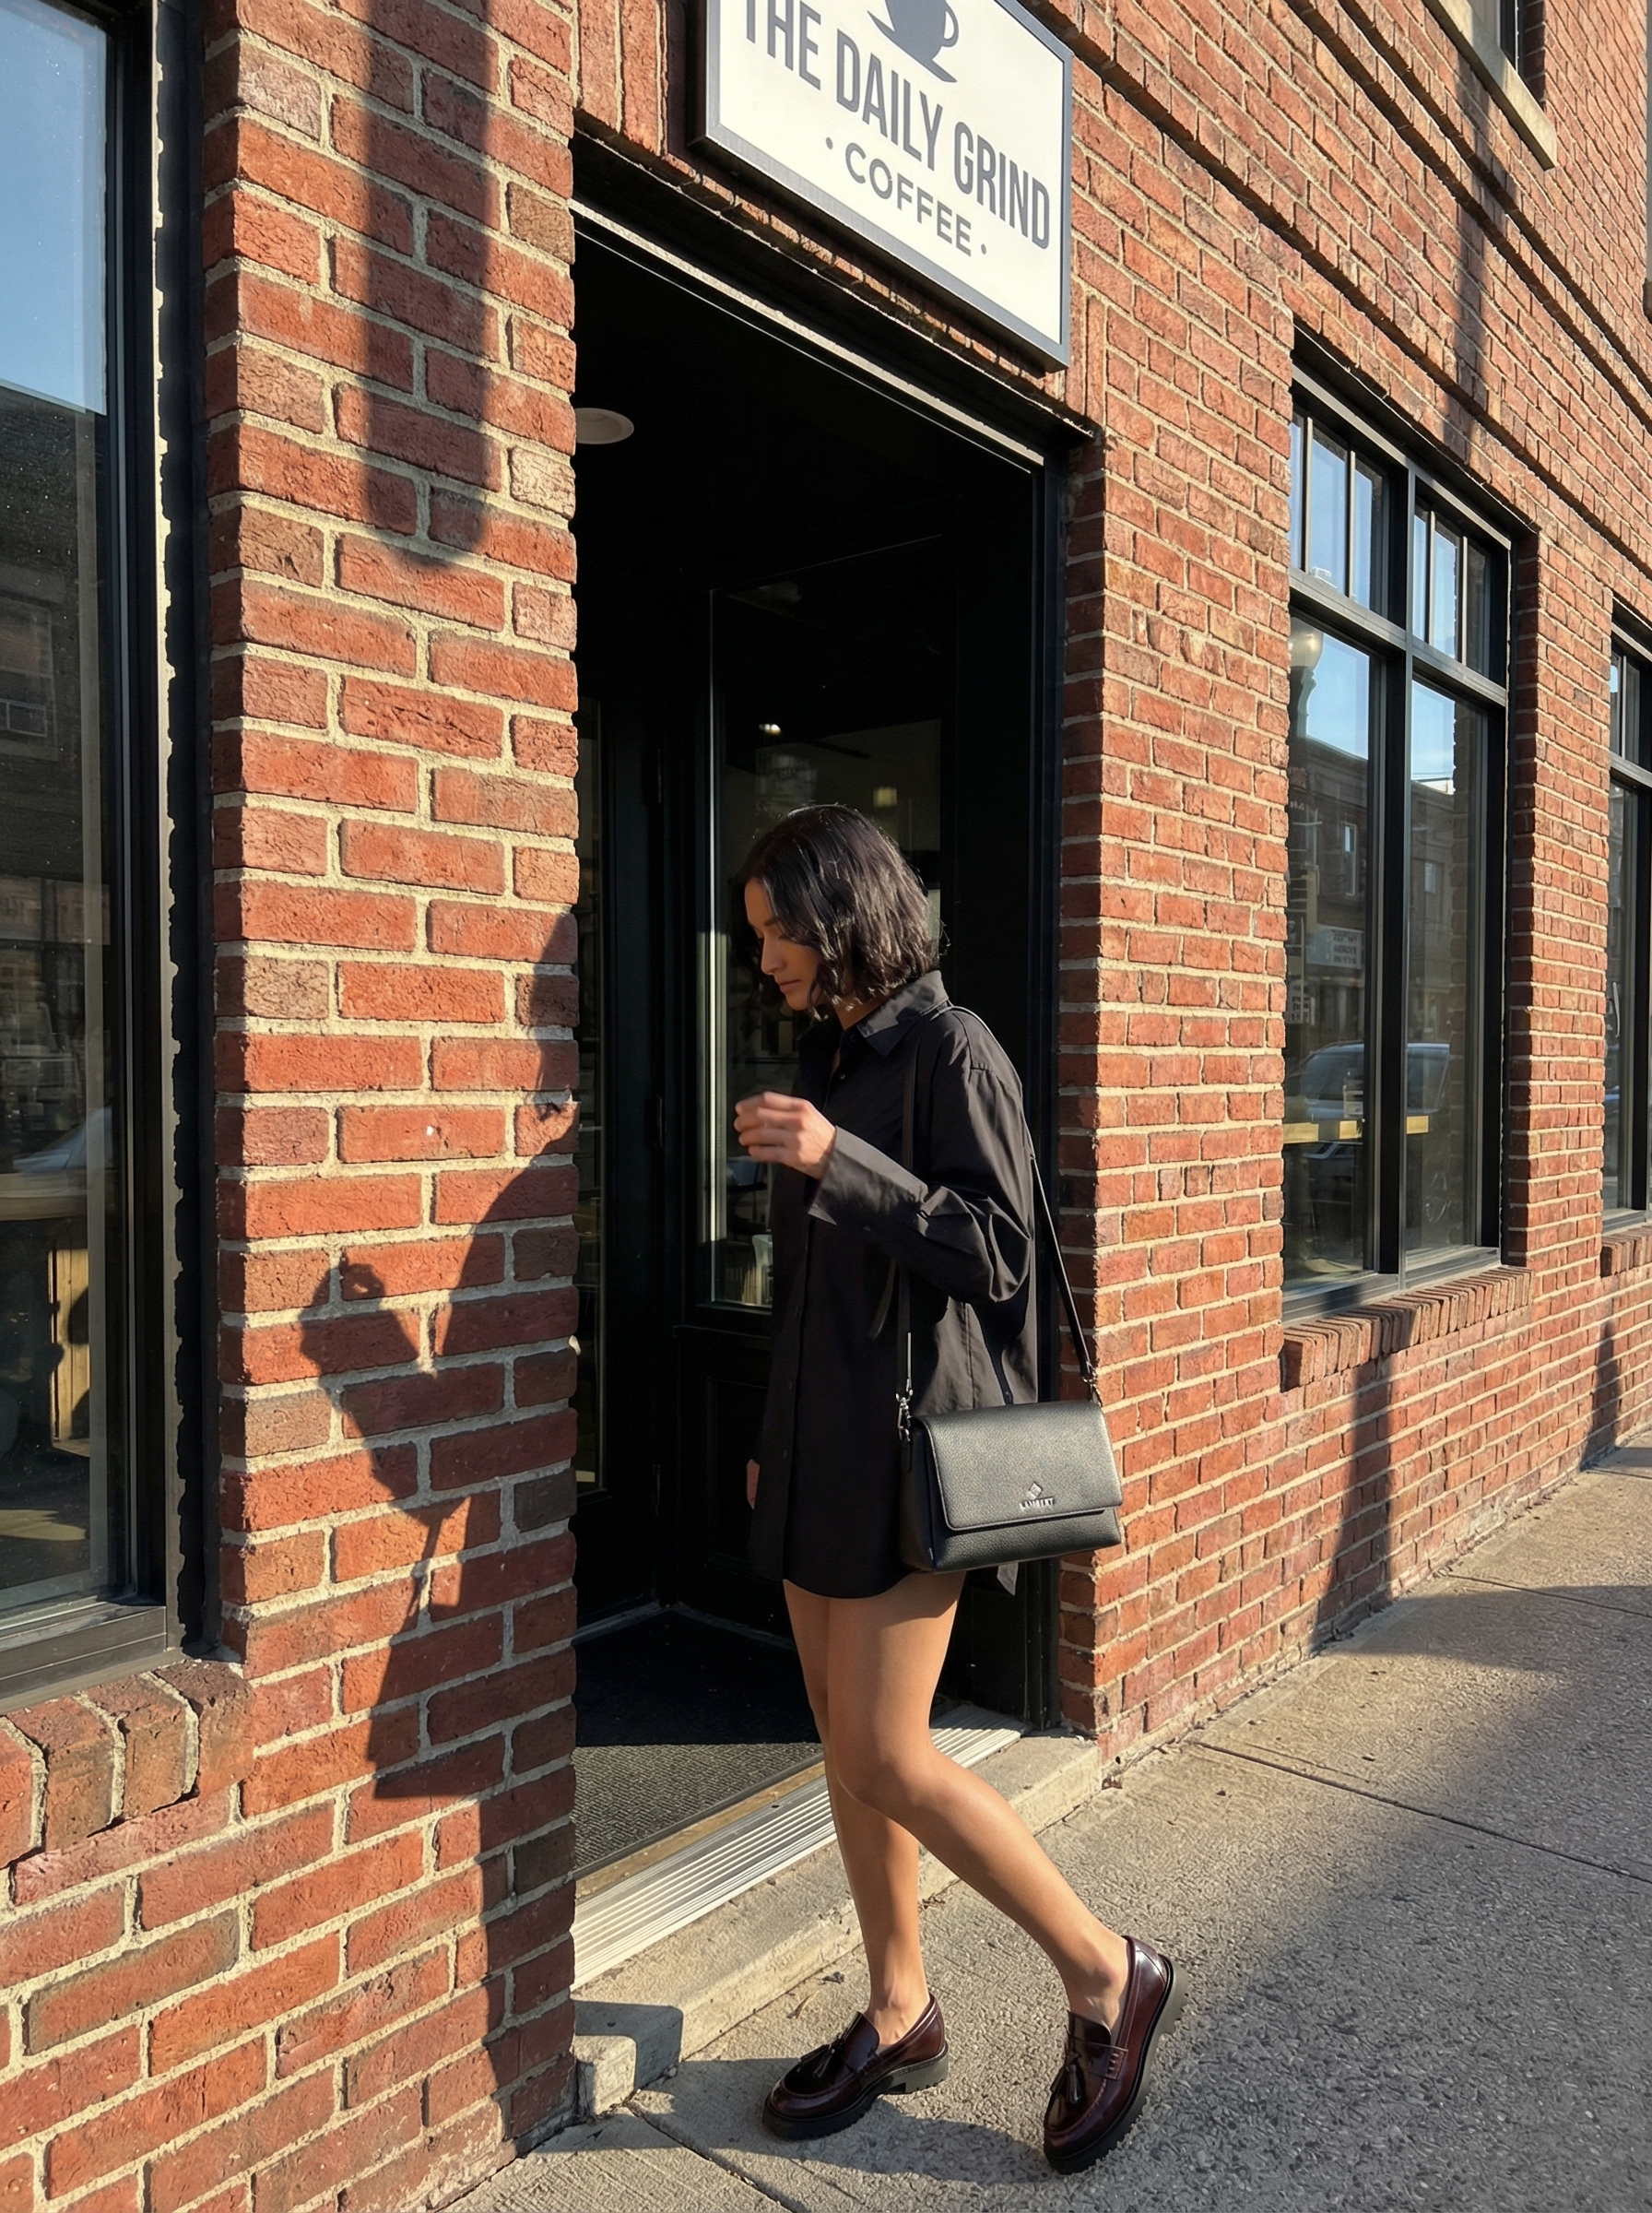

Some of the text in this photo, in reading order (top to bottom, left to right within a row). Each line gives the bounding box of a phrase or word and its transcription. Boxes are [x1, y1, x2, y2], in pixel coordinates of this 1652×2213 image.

[836, 28, 944, 172] DAILY
[953, 121, 1050, 250] GRIND
[844, 142, 972, 257] COFFEE
